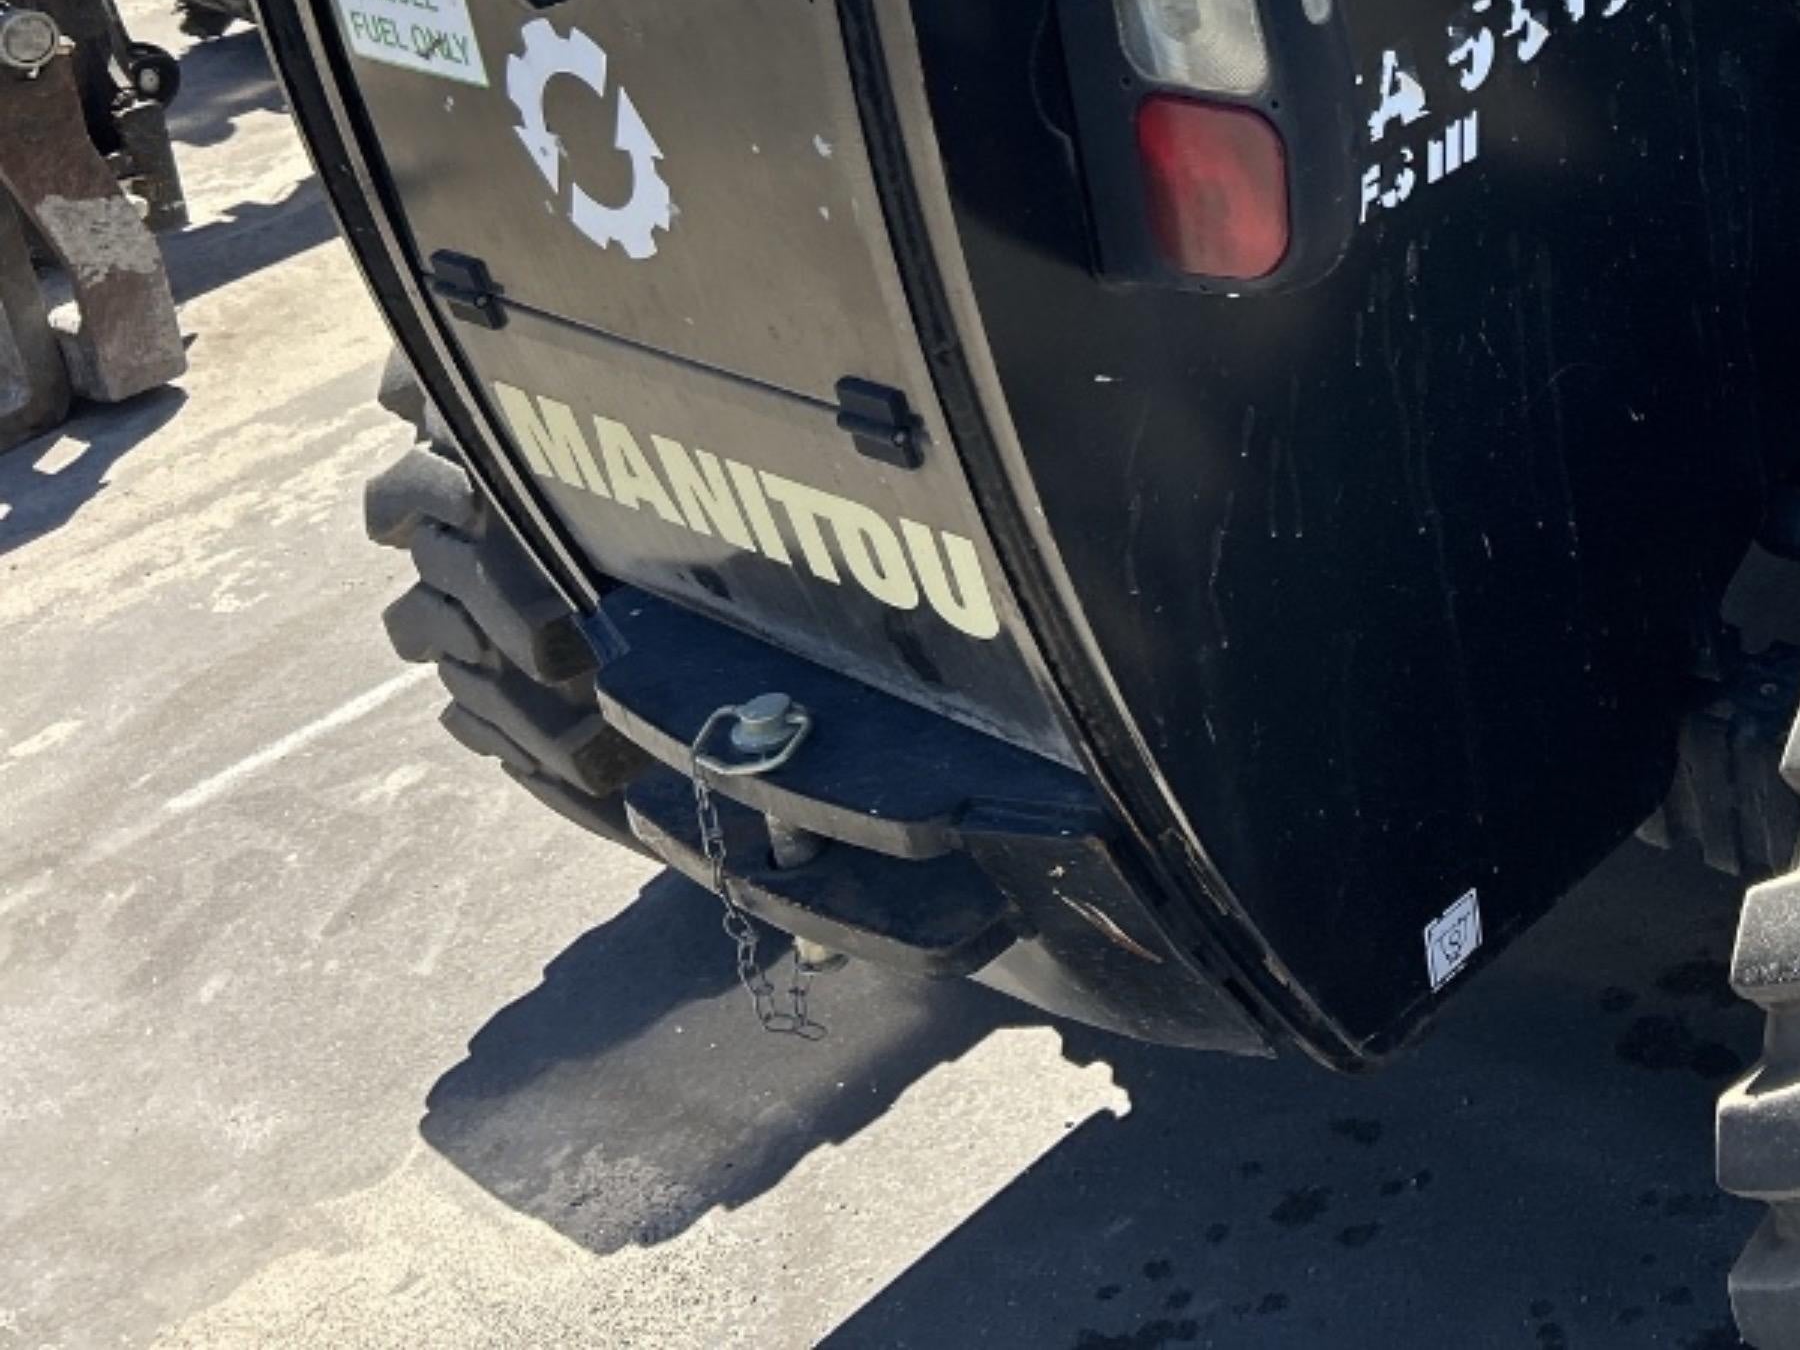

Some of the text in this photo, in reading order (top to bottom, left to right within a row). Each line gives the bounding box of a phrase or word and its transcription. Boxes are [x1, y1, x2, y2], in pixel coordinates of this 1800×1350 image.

[350, 11, 470, 66] FUEL ONLY
[1356, 50, 1430, 142] A
[494, 380, 1000, 641] MANITOU
